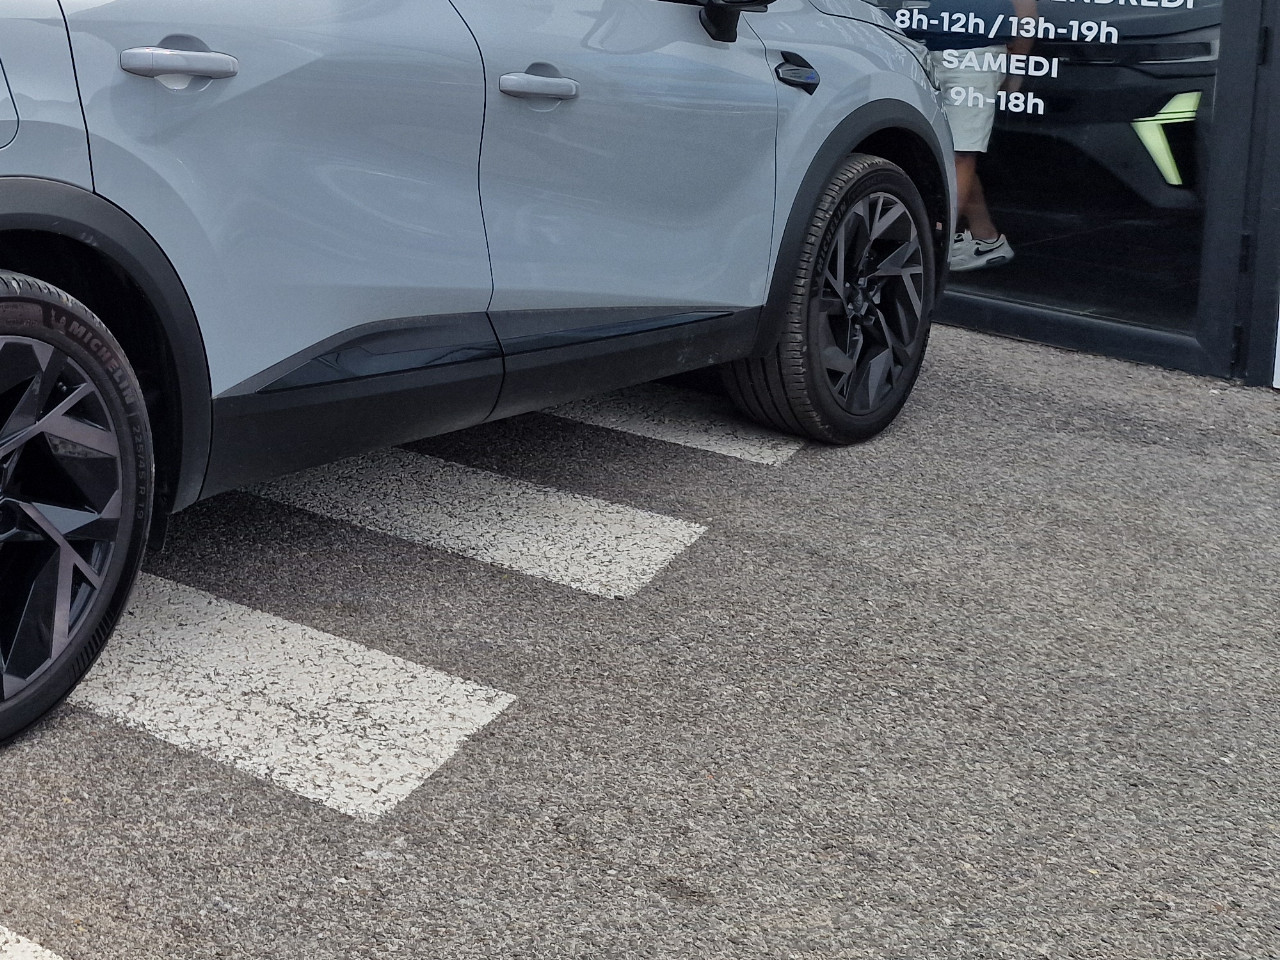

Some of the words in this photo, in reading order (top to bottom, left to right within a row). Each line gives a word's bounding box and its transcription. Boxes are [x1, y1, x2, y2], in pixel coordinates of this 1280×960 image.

[894, 8, 986, 35] 8h-12h
[1008, 17, 1119, 44] 13h-19h
[941, 49, 1060, 79] SAMEDI
[949, 86, 1045, 116] 9h-18h
[67, 320, 136, 405] MICHELIN
